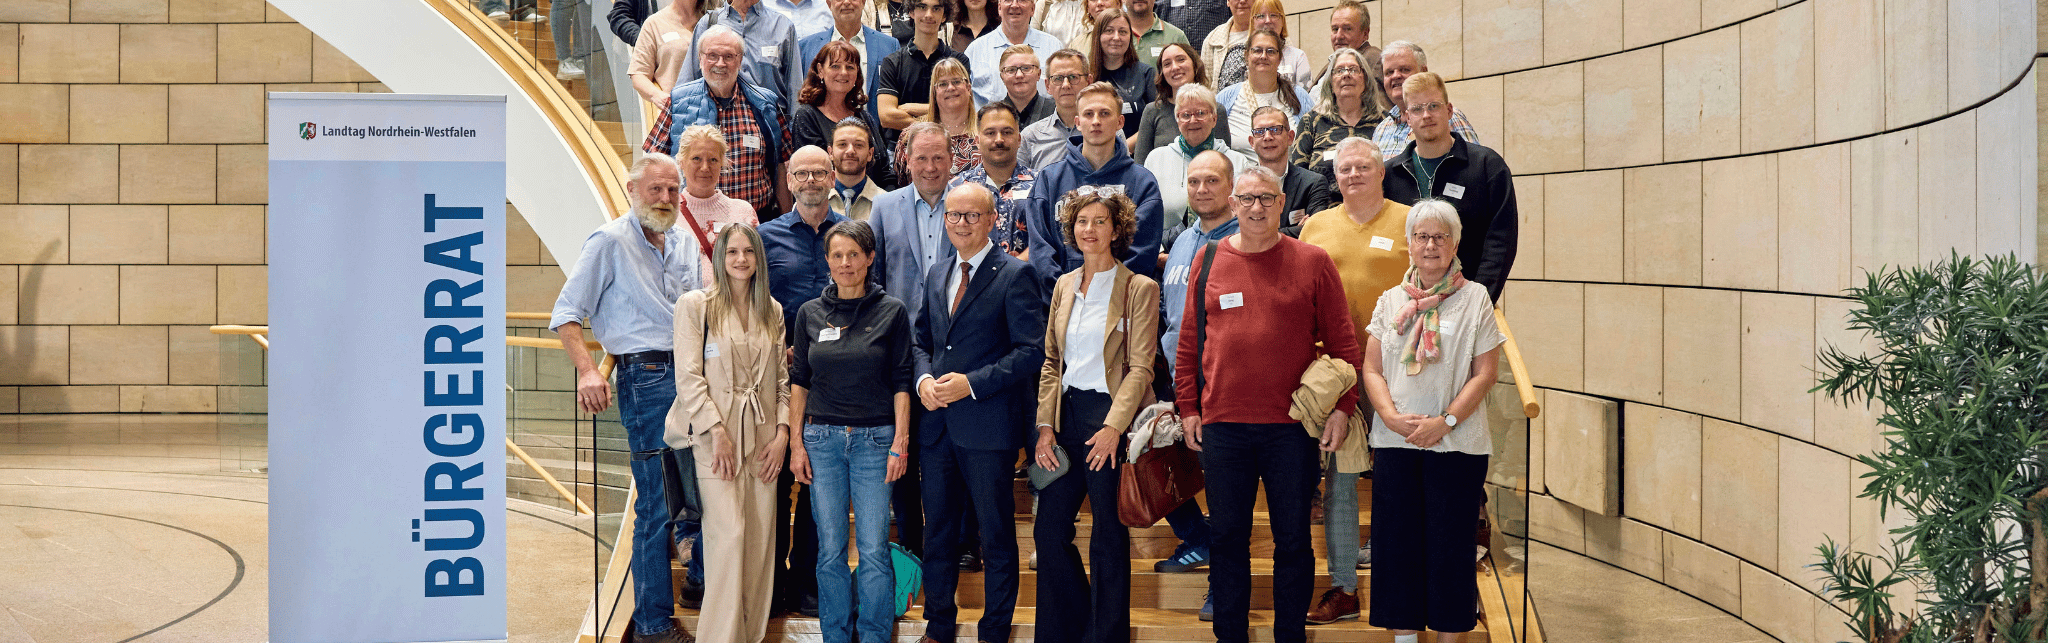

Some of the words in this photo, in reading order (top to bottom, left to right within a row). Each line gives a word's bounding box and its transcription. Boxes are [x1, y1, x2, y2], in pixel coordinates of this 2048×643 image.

[322, 125, 366, 139] Landtag
[368, 125, 477, 138] Nordrhein-Westfalen
[411, 193, 485, 597] BÜRGERRAT
